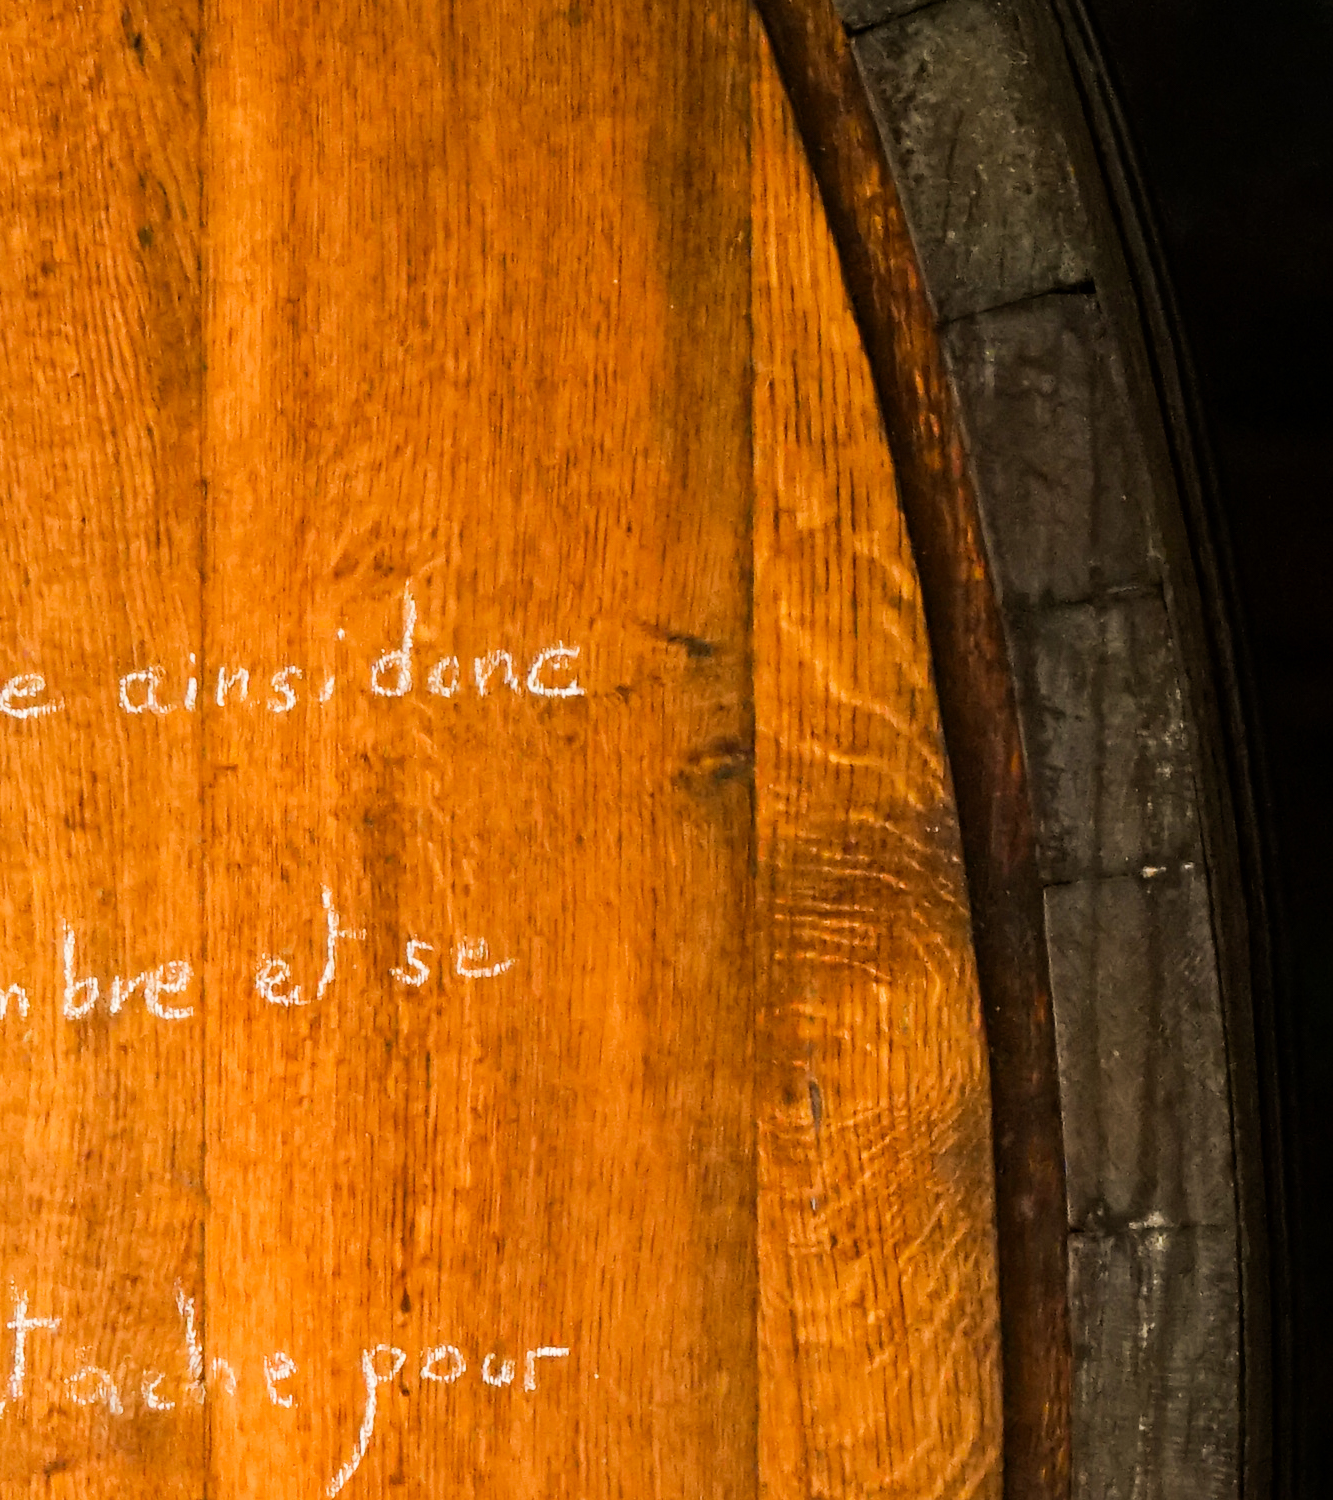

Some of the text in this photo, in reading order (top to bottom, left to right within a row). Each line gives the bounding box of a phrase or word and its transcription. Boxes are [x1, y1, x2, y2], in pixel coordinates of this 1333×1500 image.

[256, 883, 366, 1005] et
[390, 935, 514, 986] se
[326, 1344, 569, 1498] pour
